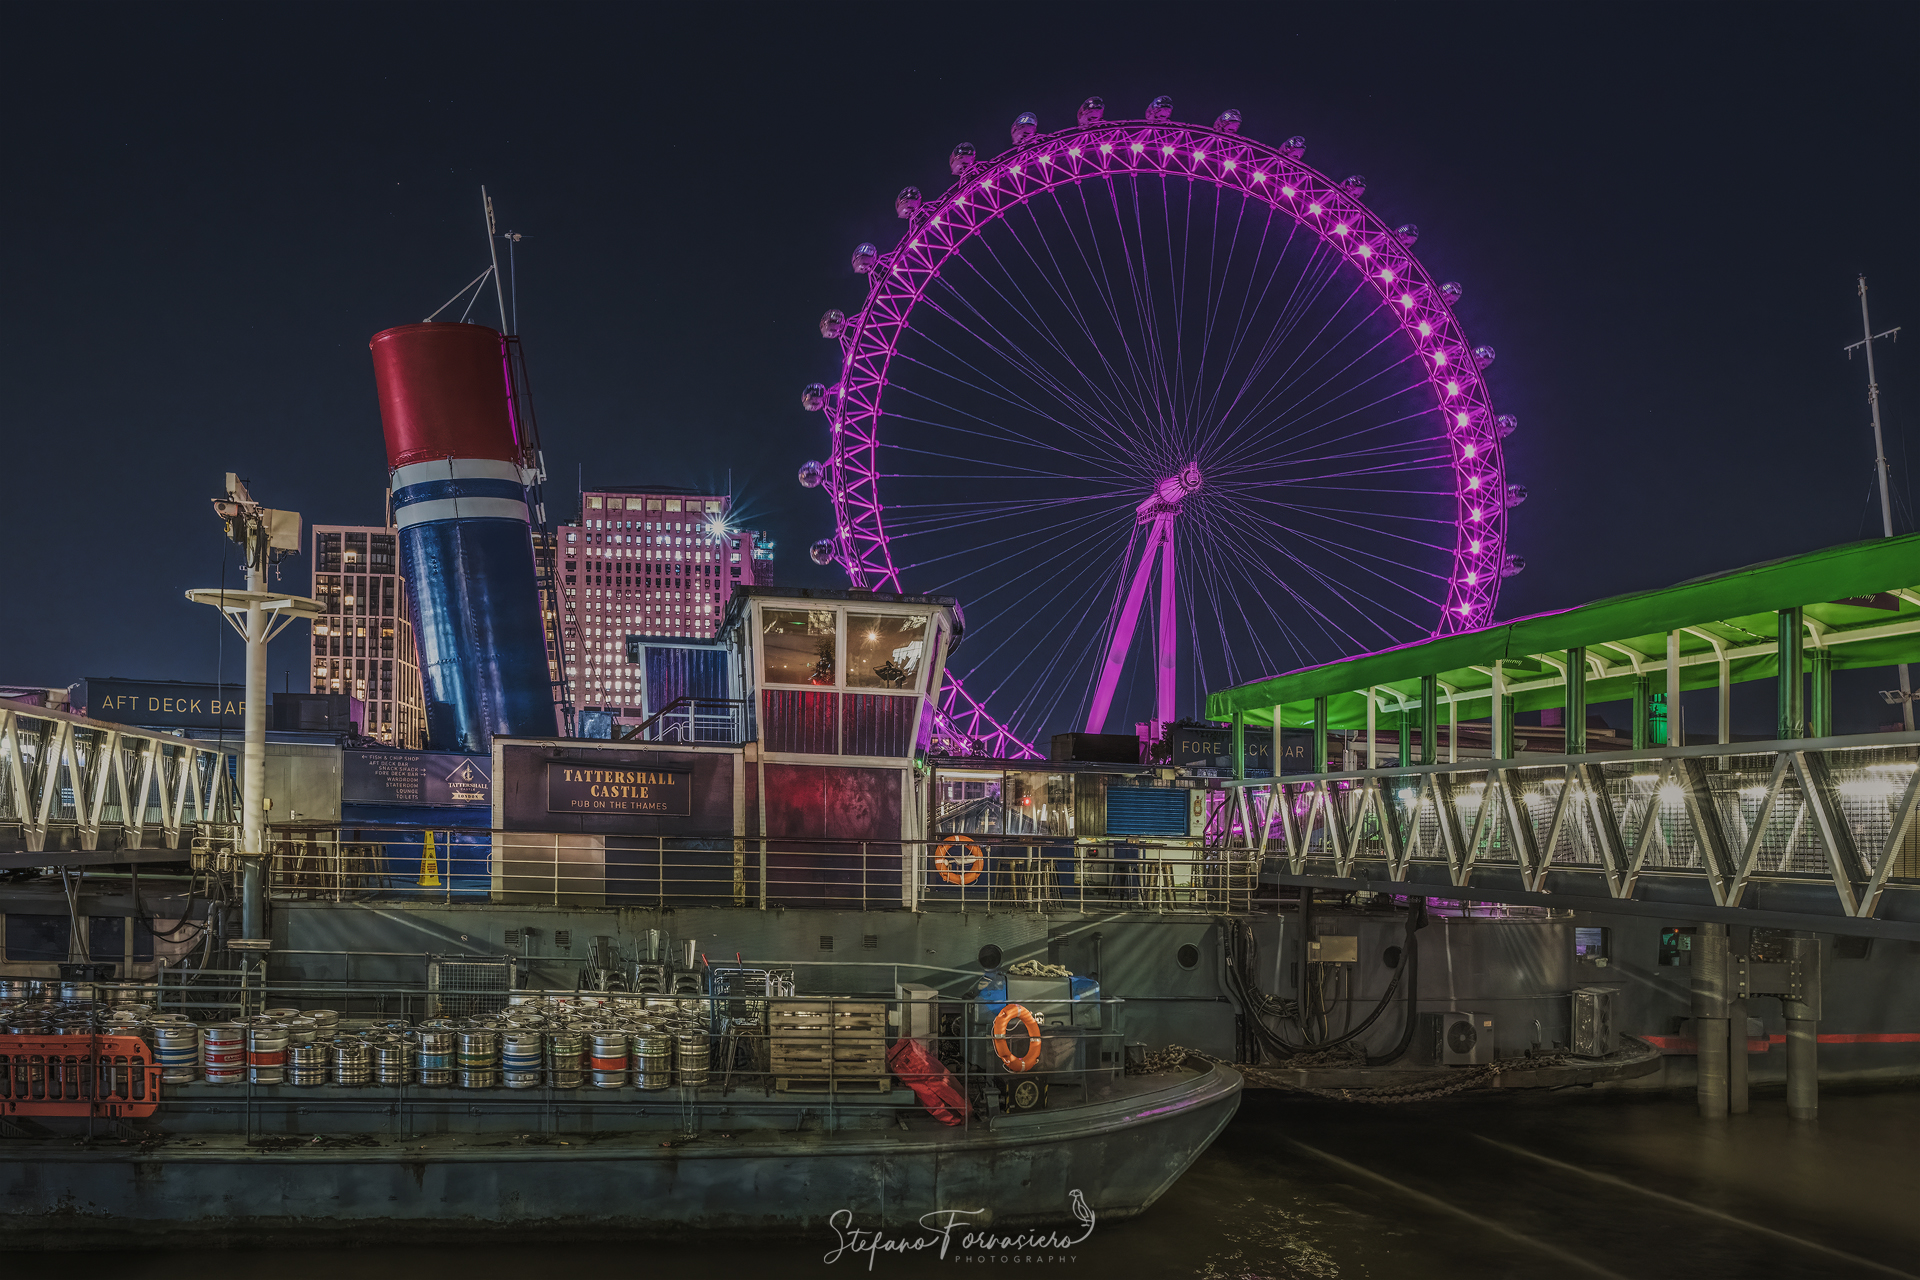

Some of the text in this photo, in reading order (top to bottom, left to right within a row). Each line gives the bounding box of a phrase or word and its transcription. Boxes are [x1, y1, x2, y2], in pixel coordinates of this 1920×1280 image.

[102, 695, 246, 716] AFT DECK BAR
[1182, 740, 1221, 755] FORE
[563, 769, 675, 785] TATTERSHALL
[448, 782, 489, 790] TATTERSHALL
[590, 785, 649, 799] CASTLE
[571, 800, 590, 808] PUB
[610, 801, 627, 809] THE
[630, 802, 668, 810] THAMES
